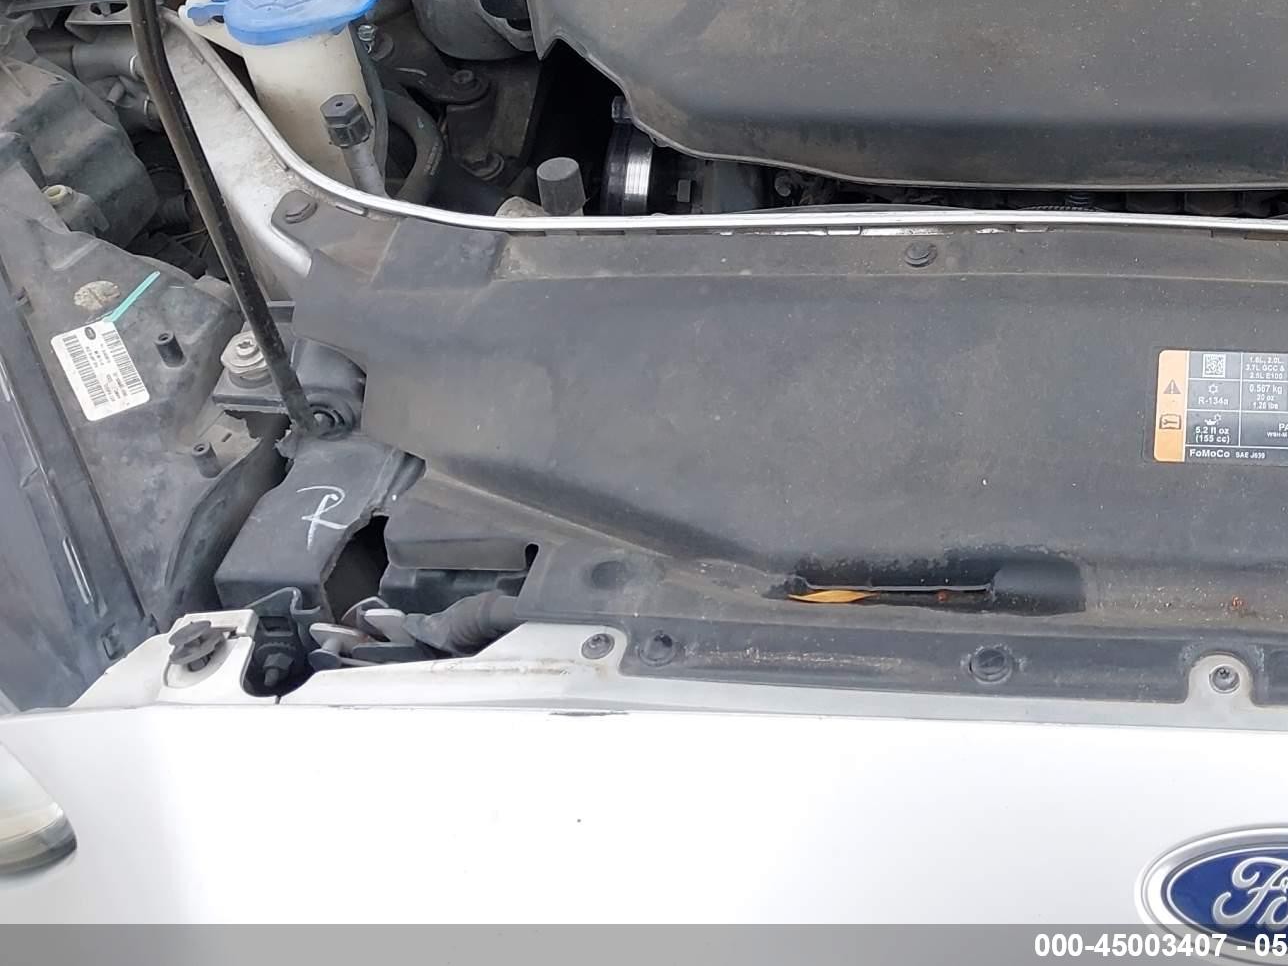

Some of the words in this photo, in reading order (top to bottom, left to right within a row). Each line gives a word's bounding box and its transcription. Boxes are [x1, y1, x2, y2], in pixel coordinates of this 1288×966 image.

[1265, 372, 1283, 380] E100
[1249, 384, 1270, 393] 0.567
[1272, 384, 1283, 394] kg
[1198, 396, 1229, 406] R-134a
[1267, 402, 1279, 410] lbs
[1195, 426, 1209, 434] 5.2
[1195, 435, 1214, 443] (155
[1216, 435, 1230, 444] cc)
[1189, 449, 1231, 458] FoMoCo
[1235, 451, 1249, 459] SAE
